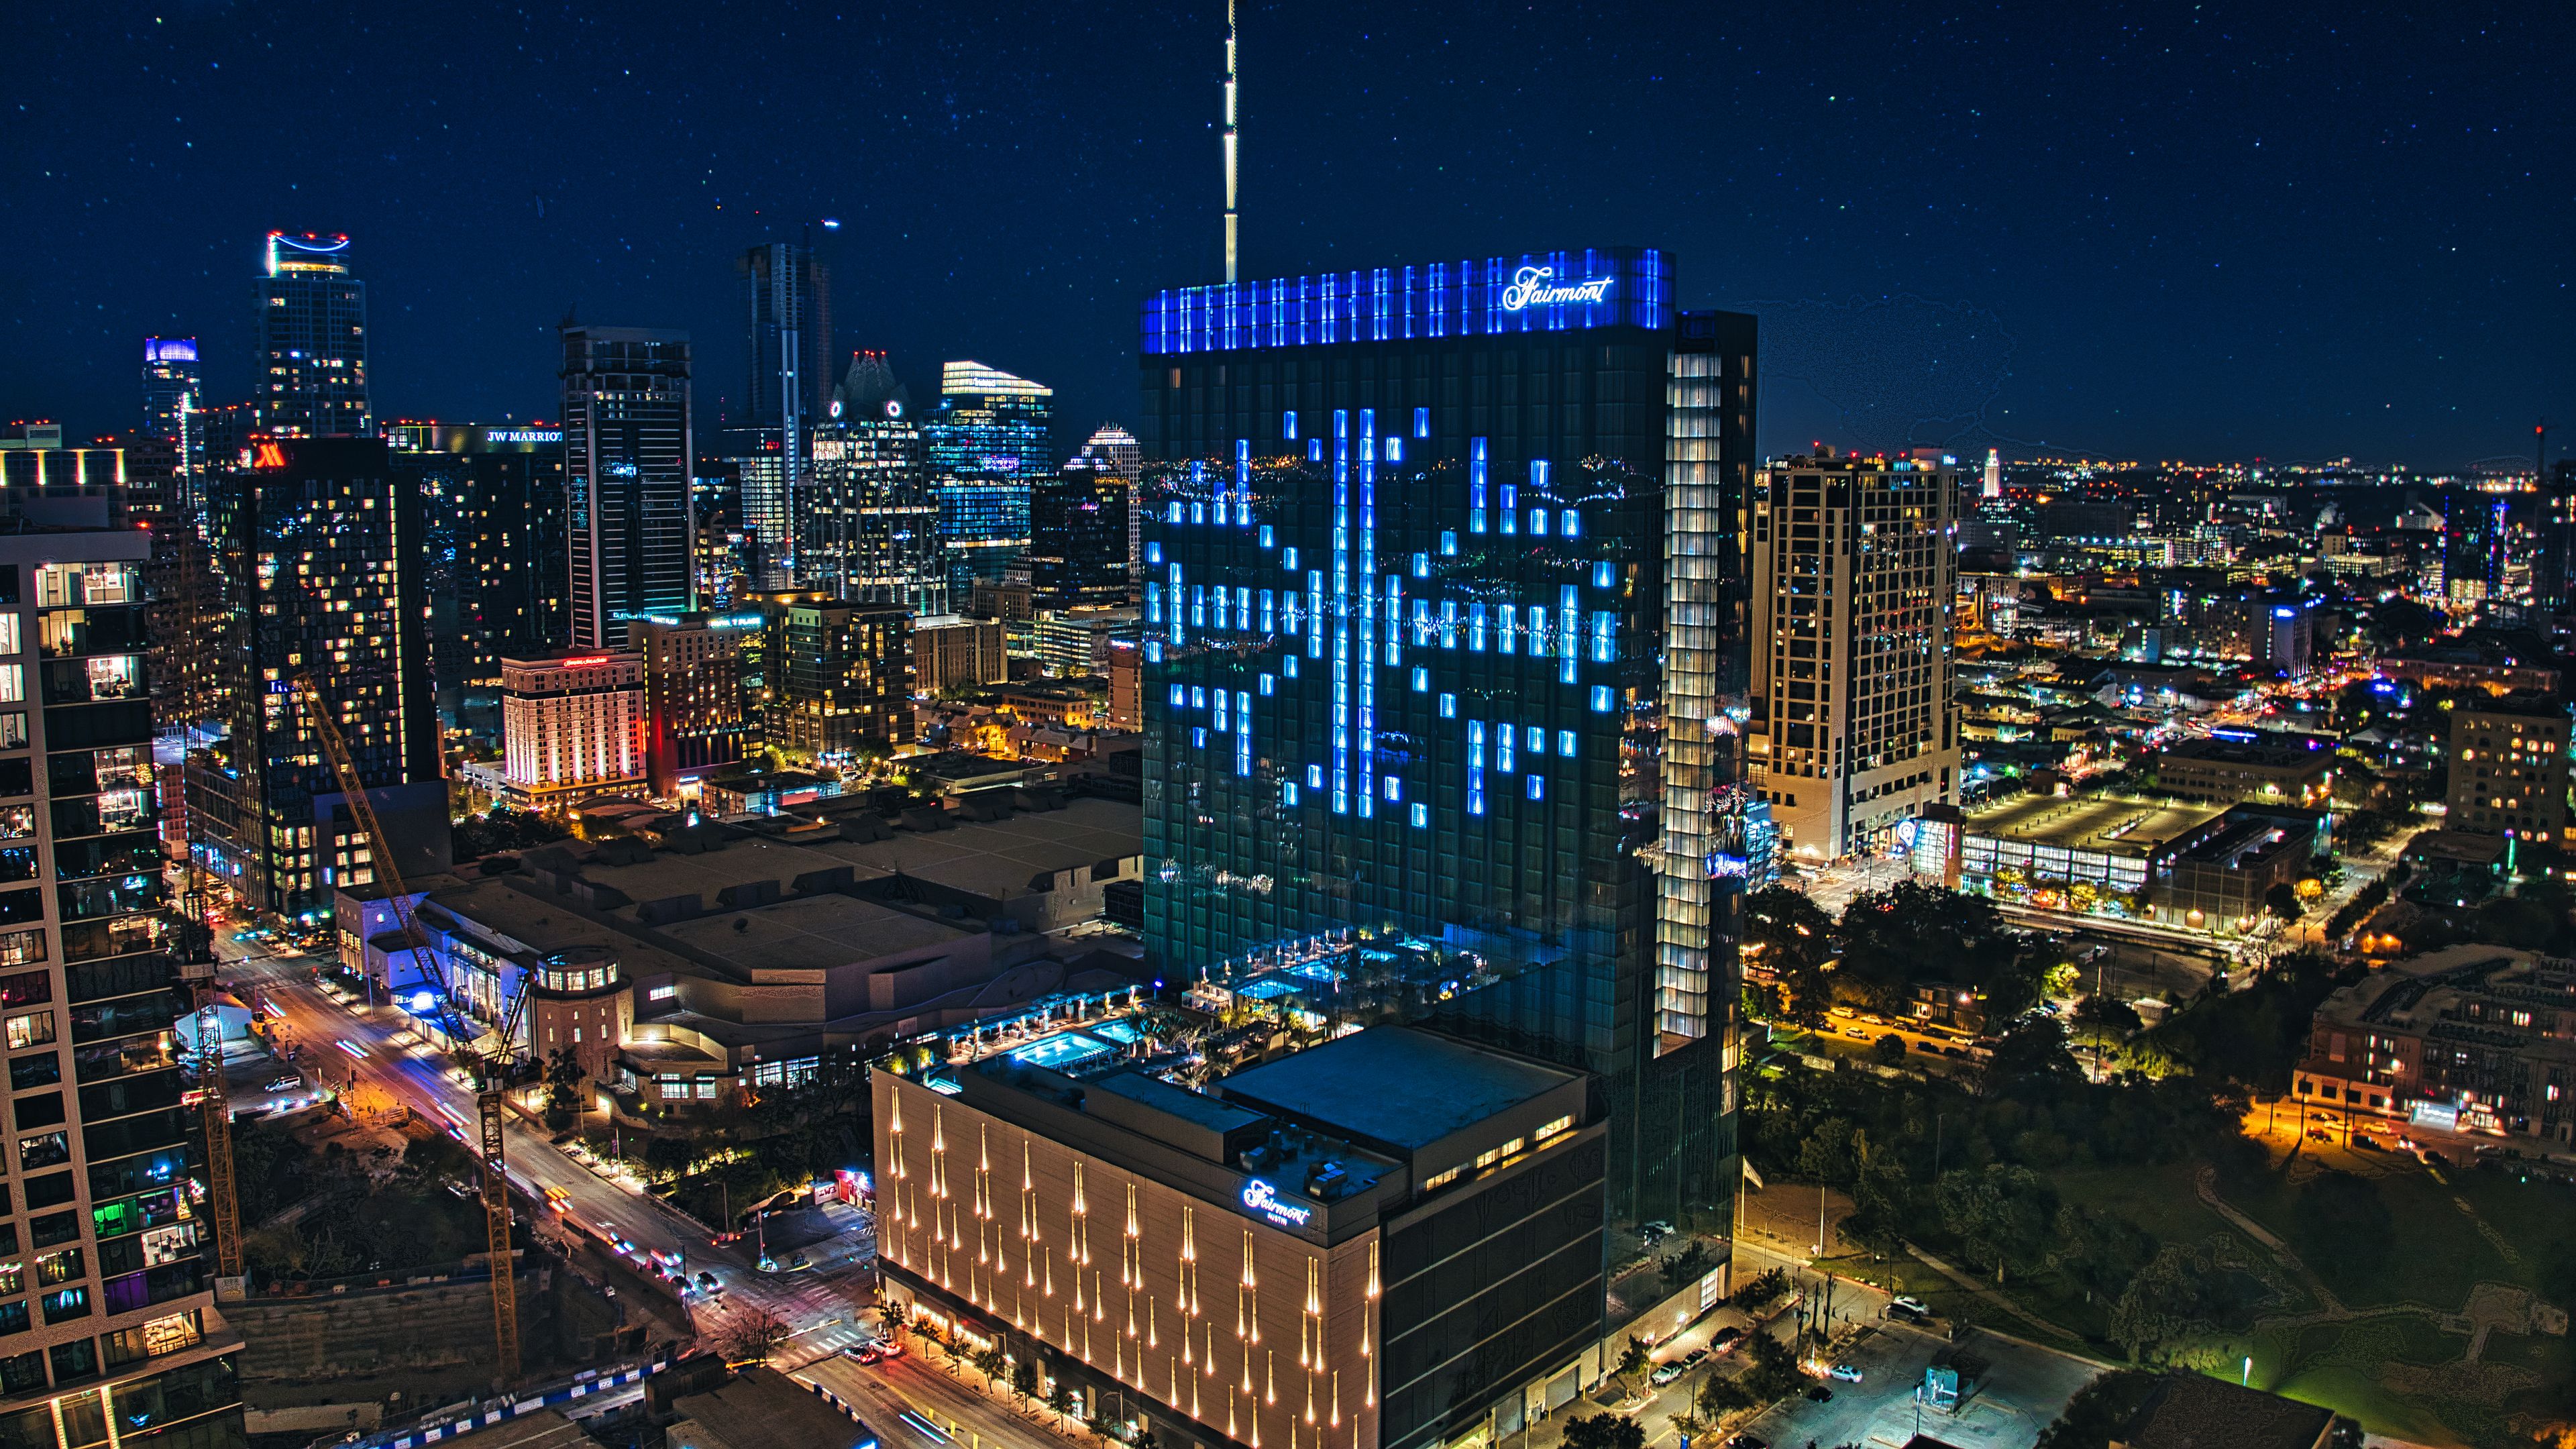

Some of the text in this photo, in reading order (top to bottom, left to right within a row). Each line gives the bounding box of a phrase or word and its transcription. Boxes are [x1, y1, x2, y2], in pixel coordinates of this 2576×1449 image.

[1503, 266, 1614, 311] Fairmont
[488, 431, 507, 442] JW
[1244, 1179, 1311, 1226] Fairmont
[1267, 1212, 1287, 1226] AUSTIN
